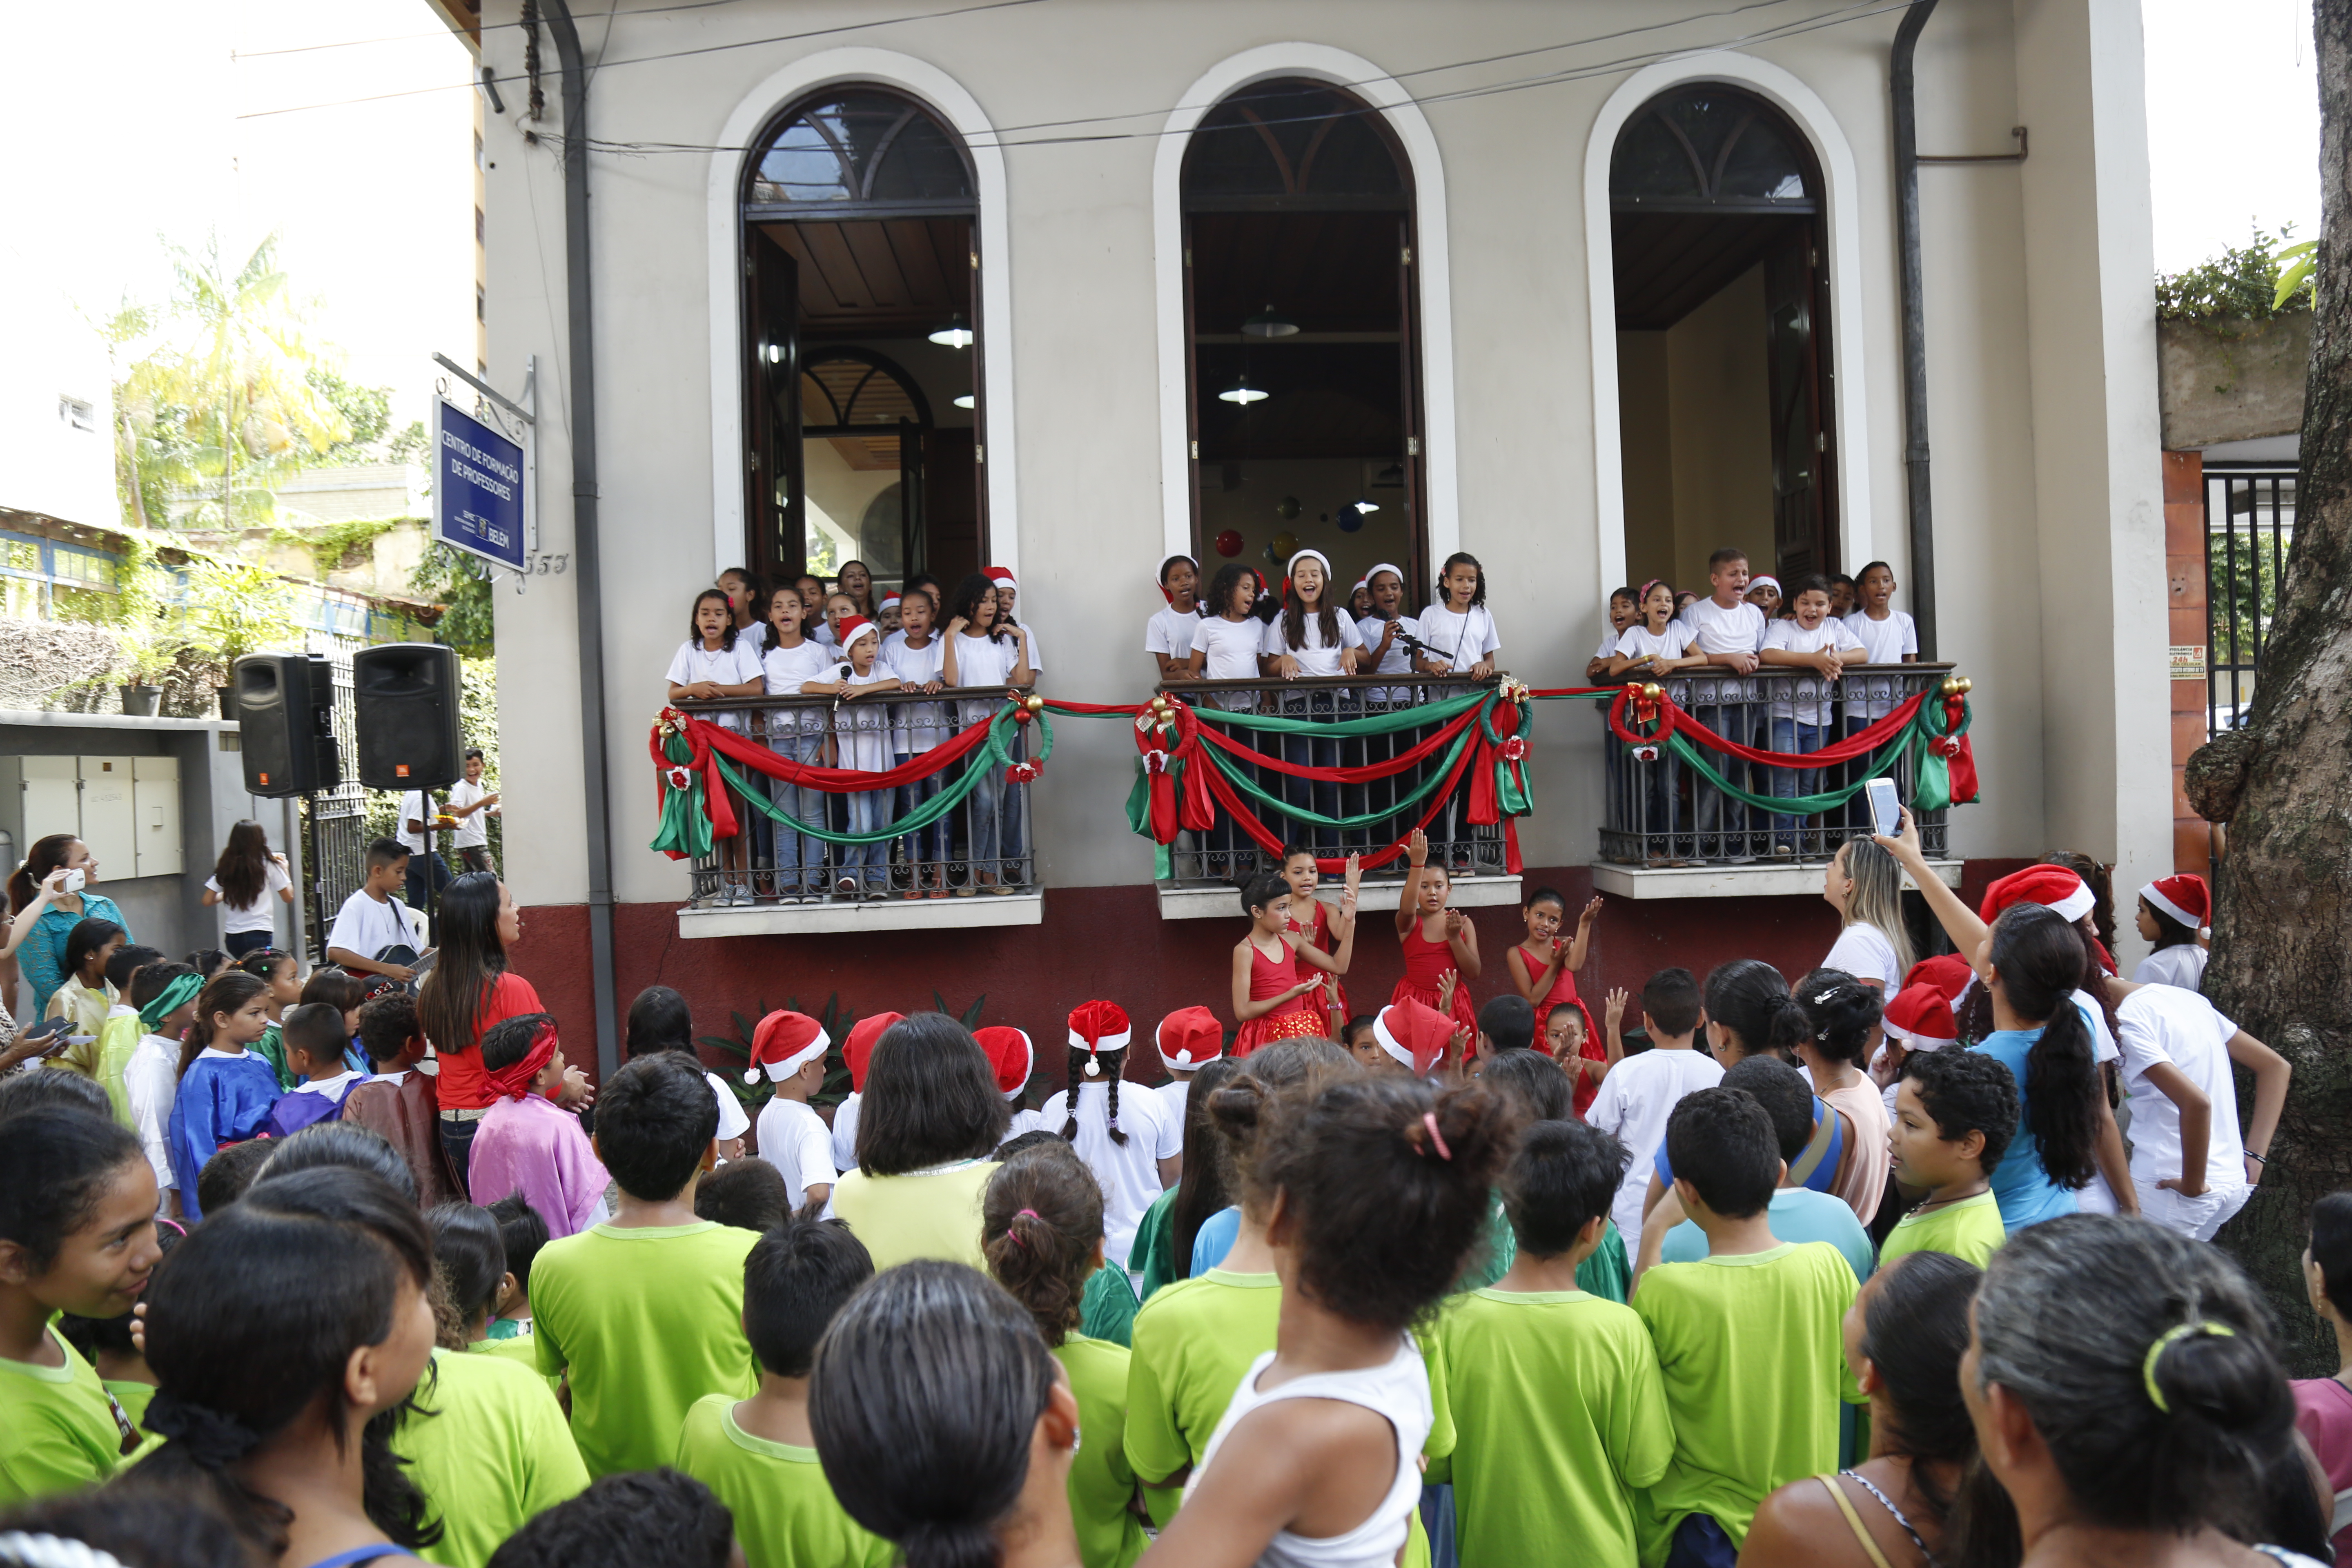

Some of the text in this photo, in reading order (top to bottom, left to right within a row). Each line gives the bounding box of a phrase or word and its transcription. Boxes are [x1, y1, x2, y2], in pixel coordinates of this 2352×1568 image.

[442, 429, 519, 484] CENTRO DE FORMAÇÃO
[452, 458, 511, 501] DE PROFESSORES
[488, 527, 509, 549] BELÉM
